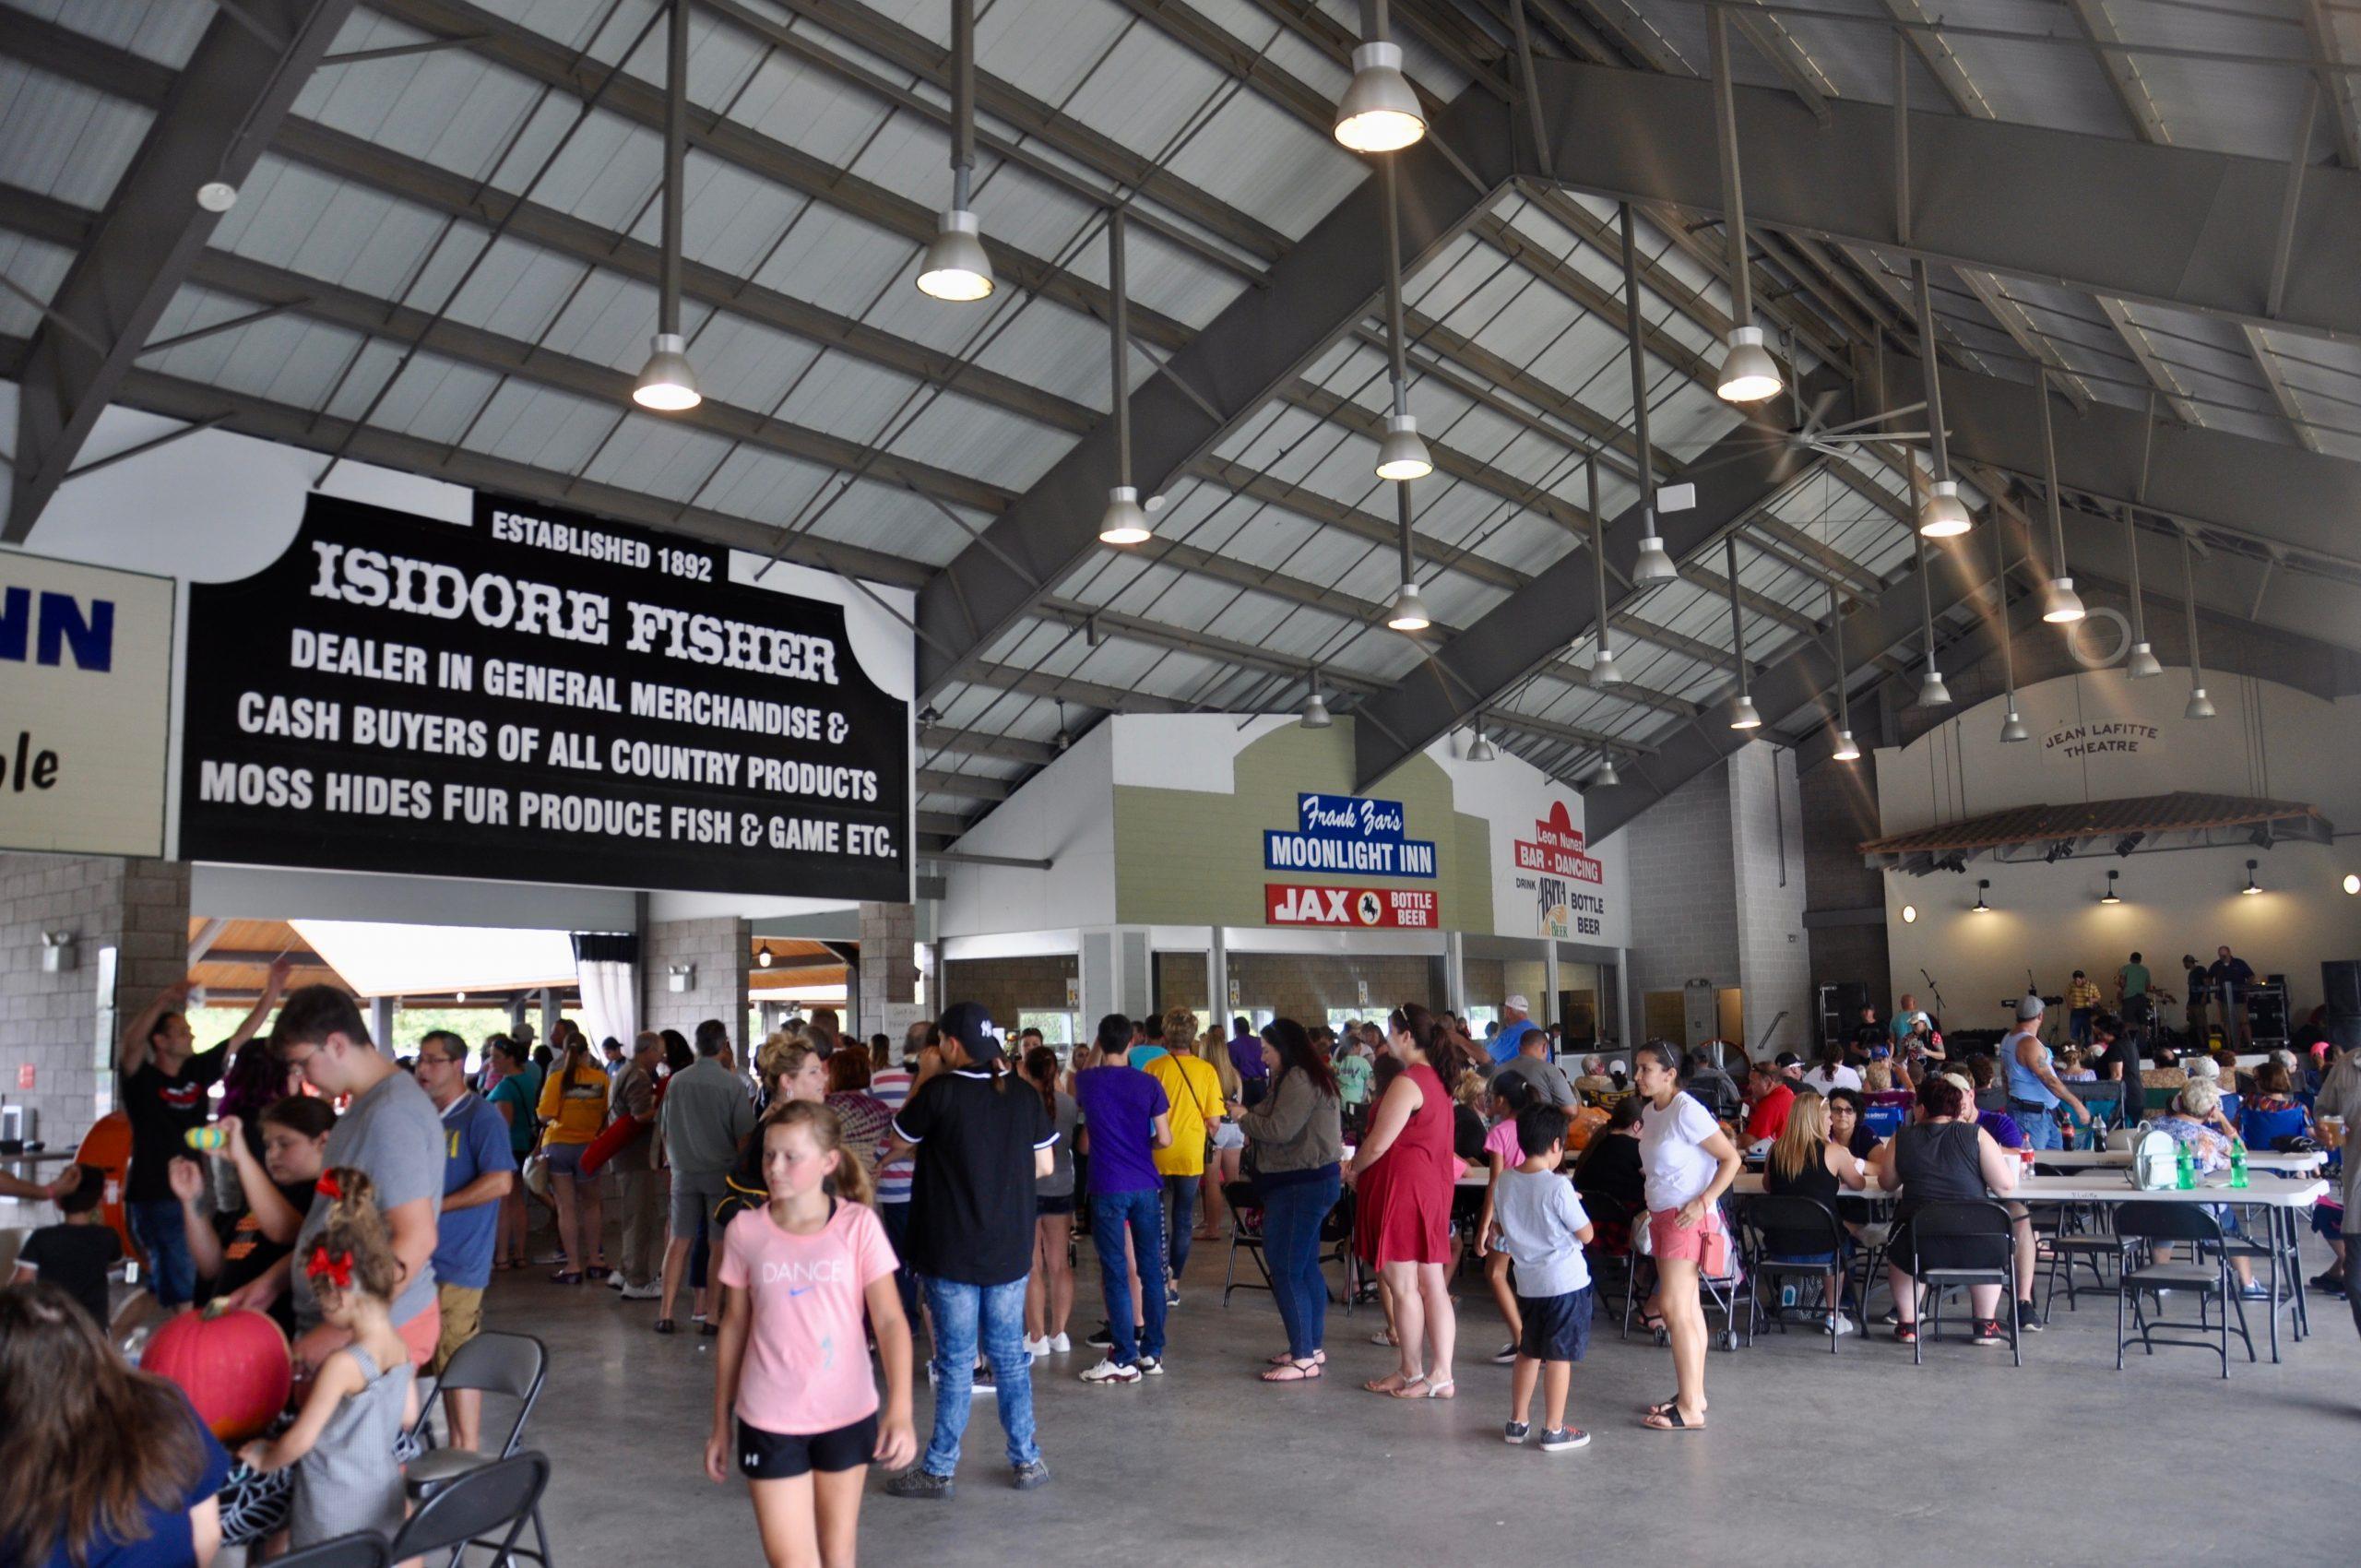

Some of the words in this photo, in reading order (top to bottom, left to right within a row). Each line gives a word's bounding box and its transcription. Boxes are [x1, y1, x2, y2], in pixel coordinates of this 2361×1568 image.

[492, 510, 649, 568] ESTABLISHED
[658, 548, 713, 583] 1892
[310, 540, 610, 646] ISIDORE
[626, 601, 839, 685] FISHER
[291, 628, 427, 685] DEALER
[438, 651, 472, 692] IN
[483, 659, 622, 713] GENERAL
[630, 681, 821, 741] MERCHANDISE
[826, 712, 849, 744] &
[238, 692, 340, 742] CASH
[353, 706, 488, 758] BUYERS
[497, 724, 540, 763] OF
[548, 731, 602, 771] ALL
[611, 738, 741, 786] COUNTRY
[747, 756, 877, 802] PRODUCTS
[2046, 727, 2086, 749] JEAN
[2092, 723, 2158, 740] LAFITTE
[2064, 741, 2139, 758] THEATRE
[200, 760, 313, 810] MOSS
[326, 772, 433, 819] HIDES
[444, 784, 508, 826] FUR
[519, 791, 661, 838] PRODUCE
[670, 806, 732, 844] FISH
[740, 813, 764, 847] &
[768, 815, 839, 853] GAME
[847, 824, 898, 859] ETC.
[1302, 795, 1357, 830] Frank
[1360, 800, 1402, 836] Zar's
[1271, 835, 1394, 872] MOONLIGHT
[1399, 844, 1432, 873] INN
[1536, 826, 1558, 846] Leon
[1560, 831, 1583, 853] Nunez
[1520, 845, 1545, 869] BAR
[1554, 852, 1599, 882] DANCING
[1391, 891, 1431, 909] BOTTLE
[1515, 877, 1536, 891] DRINK
[1275, 888, 1350, 922] JAX
[1397, 909, 1427, 926] BEER
[1536, 876, 1566, 936] ABITA
[1571, 892, 1604, 914] BOTTLE
[1577, 916, 1601, 936] BEER
[762, 1261, 843, 1284] DANCE
